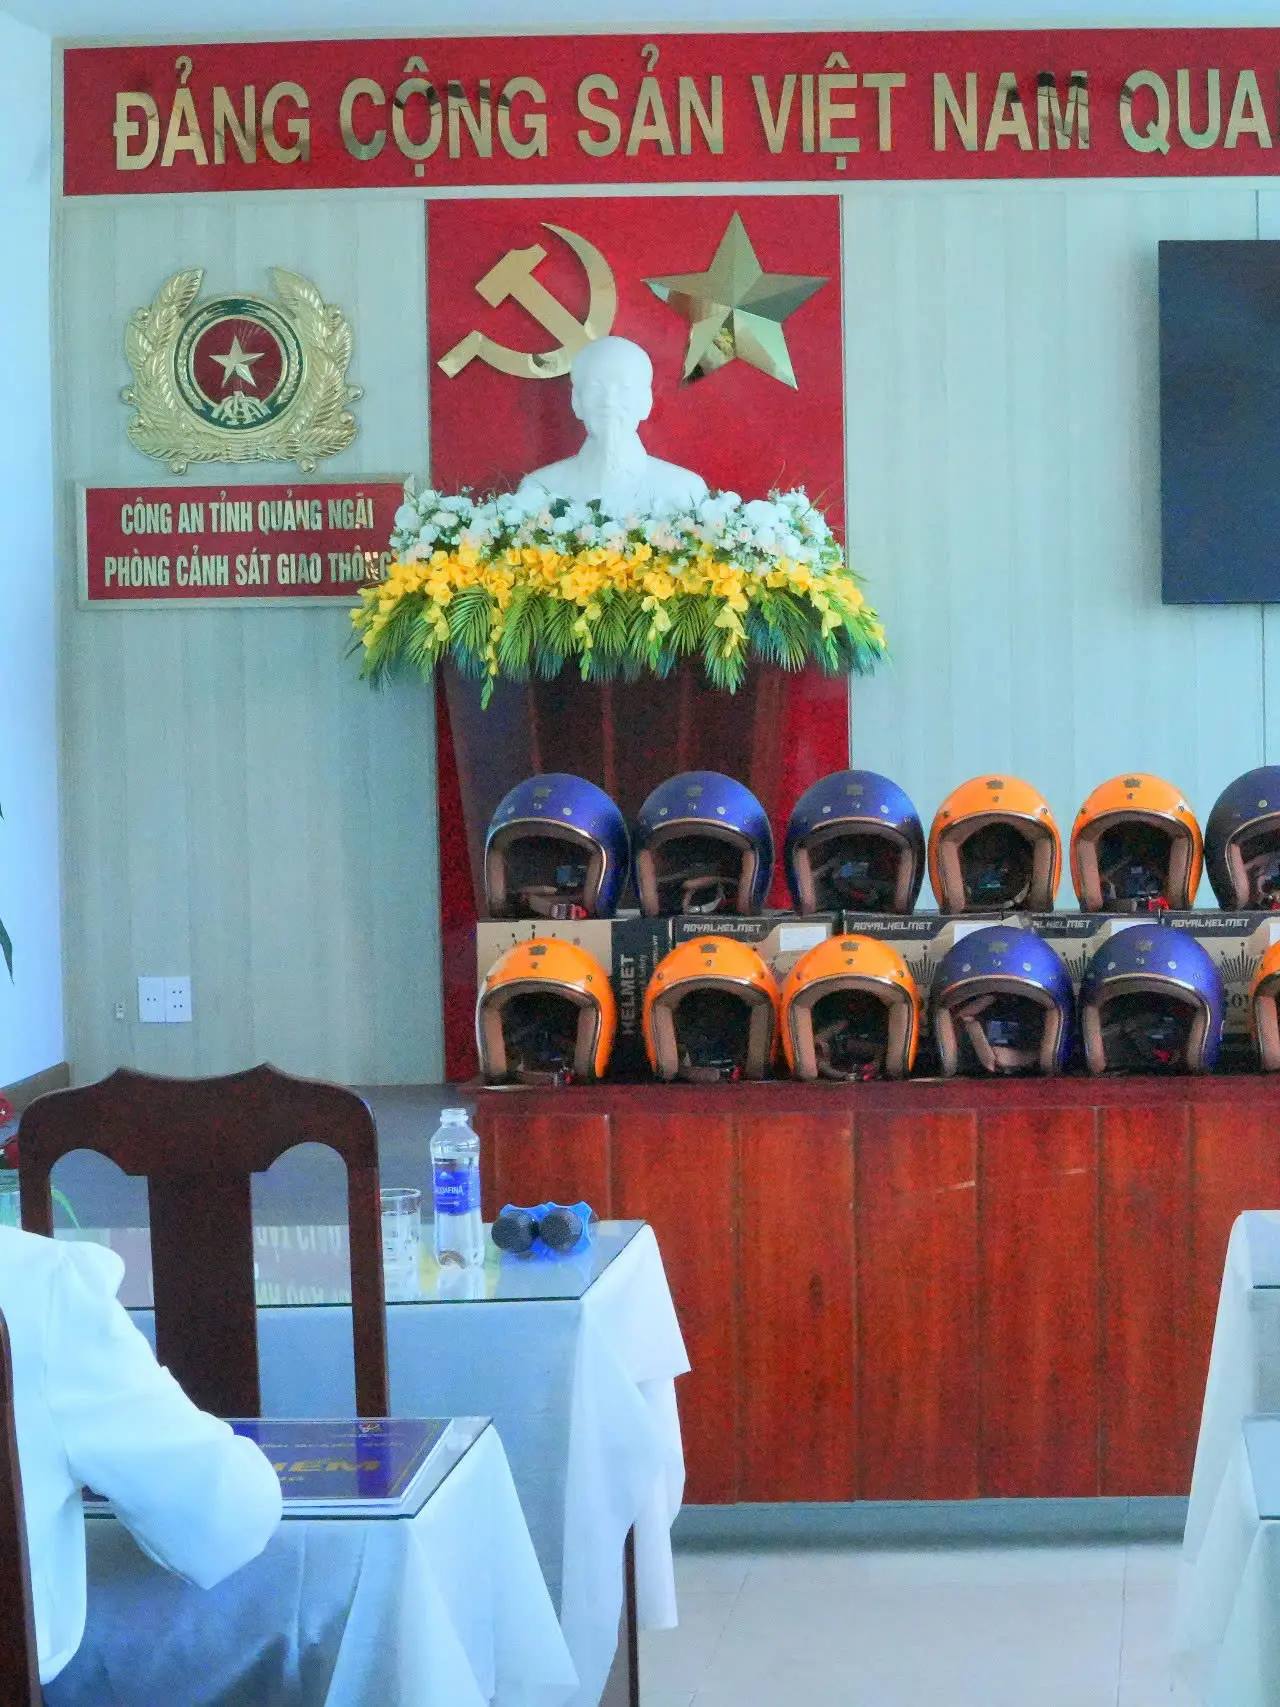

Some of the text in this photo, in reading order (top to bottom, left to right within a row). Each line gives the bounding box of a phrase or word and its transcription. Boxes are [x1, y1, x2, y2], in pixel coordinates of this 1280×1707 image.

[113, 56, 310, 171] ĐẢNG
[339, 56, 547, 177] CỘNG
[576, 43, 724, 157] SẢN
[752, 52, 905, 170] VIỆT
[933, 71, 1090, 152] NAM
[121, 488, 374, 535] CÔNG AN TỈNH QUẢNG NGÃI
[104, 547, 170, 587] PHÒNG
[176, 544, 229, 587] CẢNH
[235, 546, 271, 586] SÁT
[277, 552, 322, 585] GIAO
